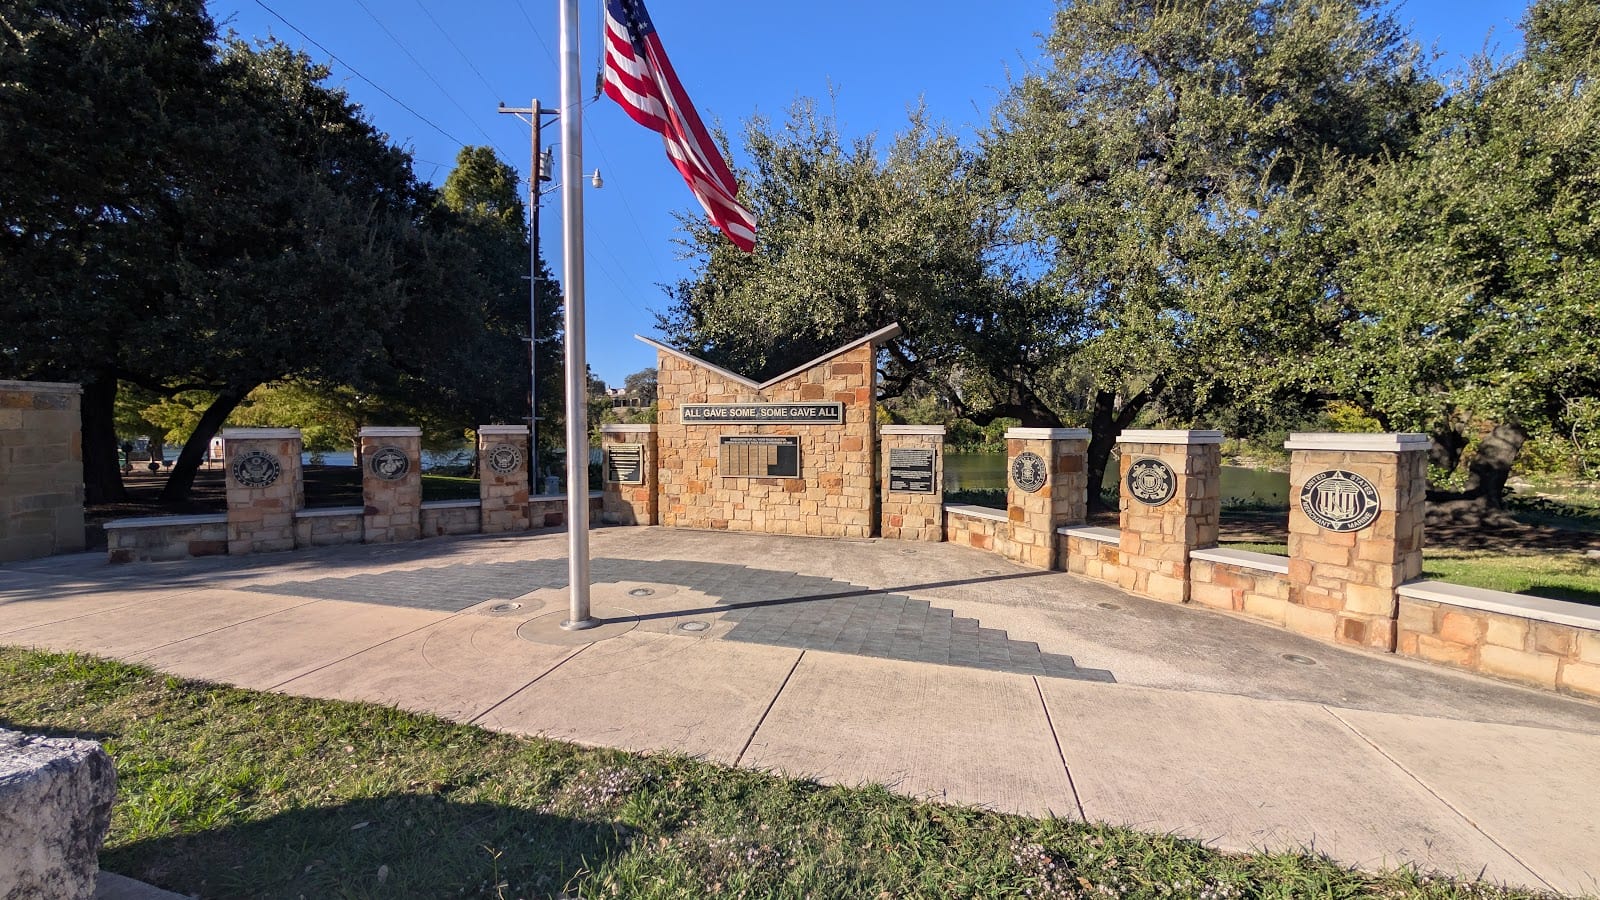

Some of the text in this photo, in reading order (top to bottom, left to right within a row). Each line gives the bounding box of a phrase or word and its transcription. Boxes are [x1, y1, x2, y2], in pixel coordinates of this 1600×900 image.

[684, 409, 701, 418] ALL
[703, 409, 727, 418] GAVE
[760, 408, 788, 417] SOME
[790, 408, 816, 417] GAVE
[818, 407, 838, 417] ALL
[1304, 473, 1374, 495] UNITED STATES
[1302, 501, 1373, 529] MERCHANT MARINE
